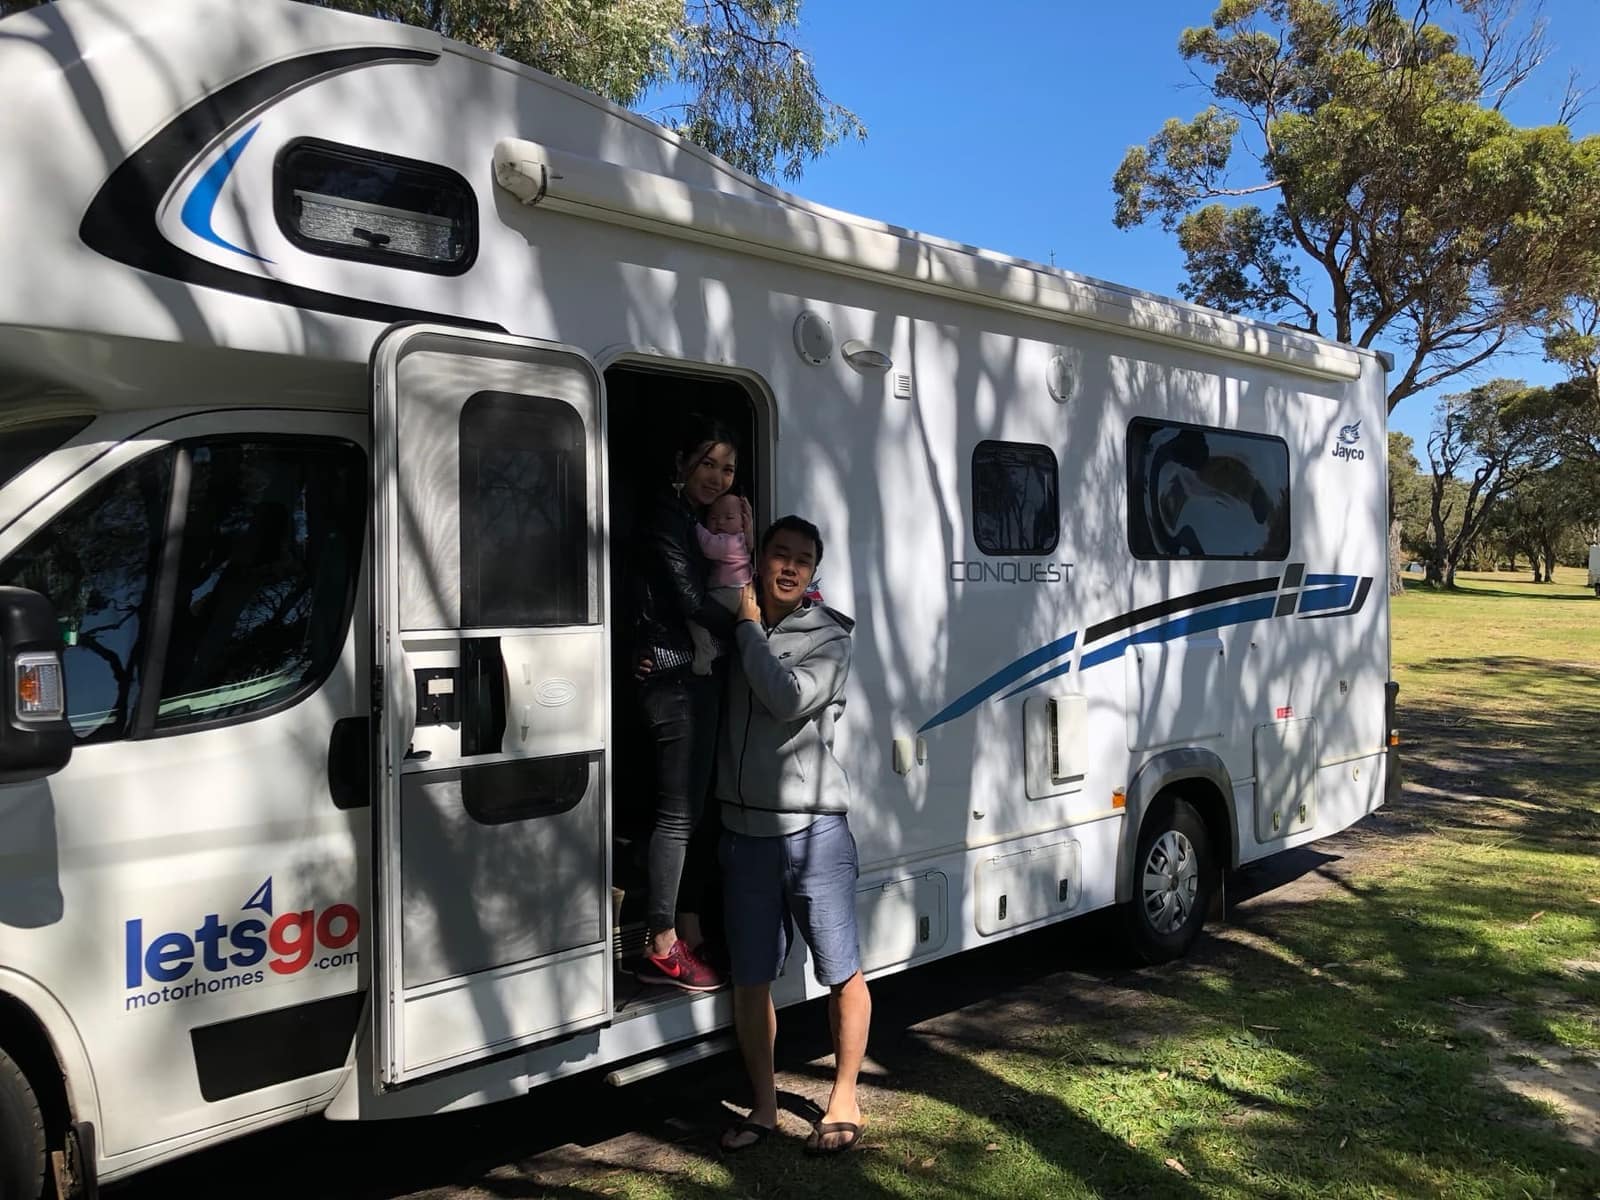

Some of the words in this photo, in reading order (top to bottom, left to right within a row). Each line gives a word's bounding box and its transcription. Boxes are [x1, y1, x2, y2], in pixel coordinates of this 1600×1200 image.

[1332, 442, 1364, 462] Jayco
[950, 561, 1074, 584] CONQUEST
[126, 970, 264, 1011] motorhomes
